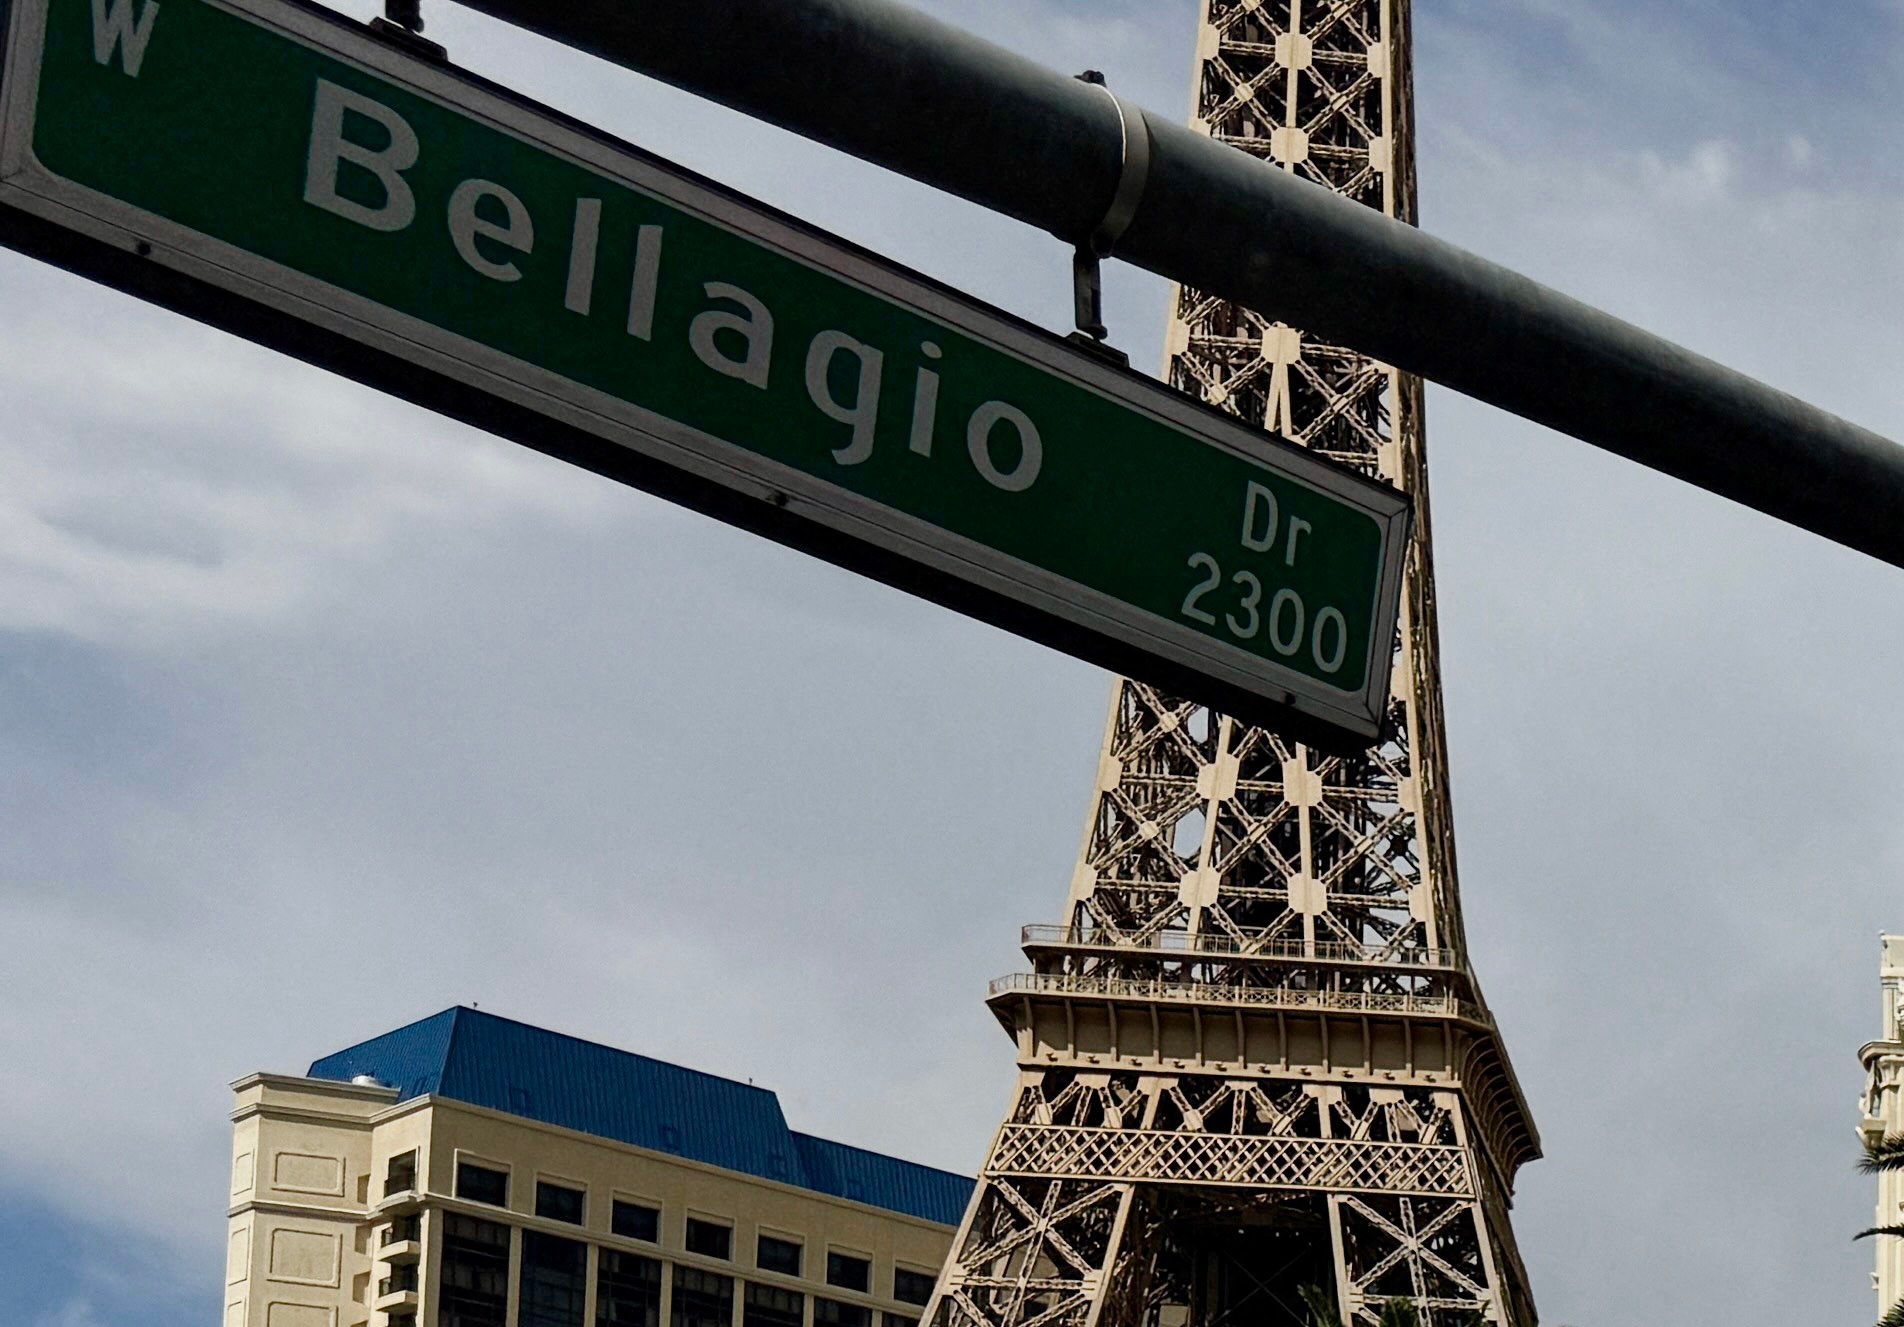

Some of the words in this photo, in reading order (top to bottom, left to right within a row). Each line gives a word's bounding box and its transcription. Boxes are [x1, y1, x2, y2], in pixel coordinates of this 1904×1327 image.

[91, 0, 160, 78] W
[302, 76, 1045, 493] Bellagio
[1239, 479, 1312, 569] Dr
[1180, 552, 1348, 675] 2300
